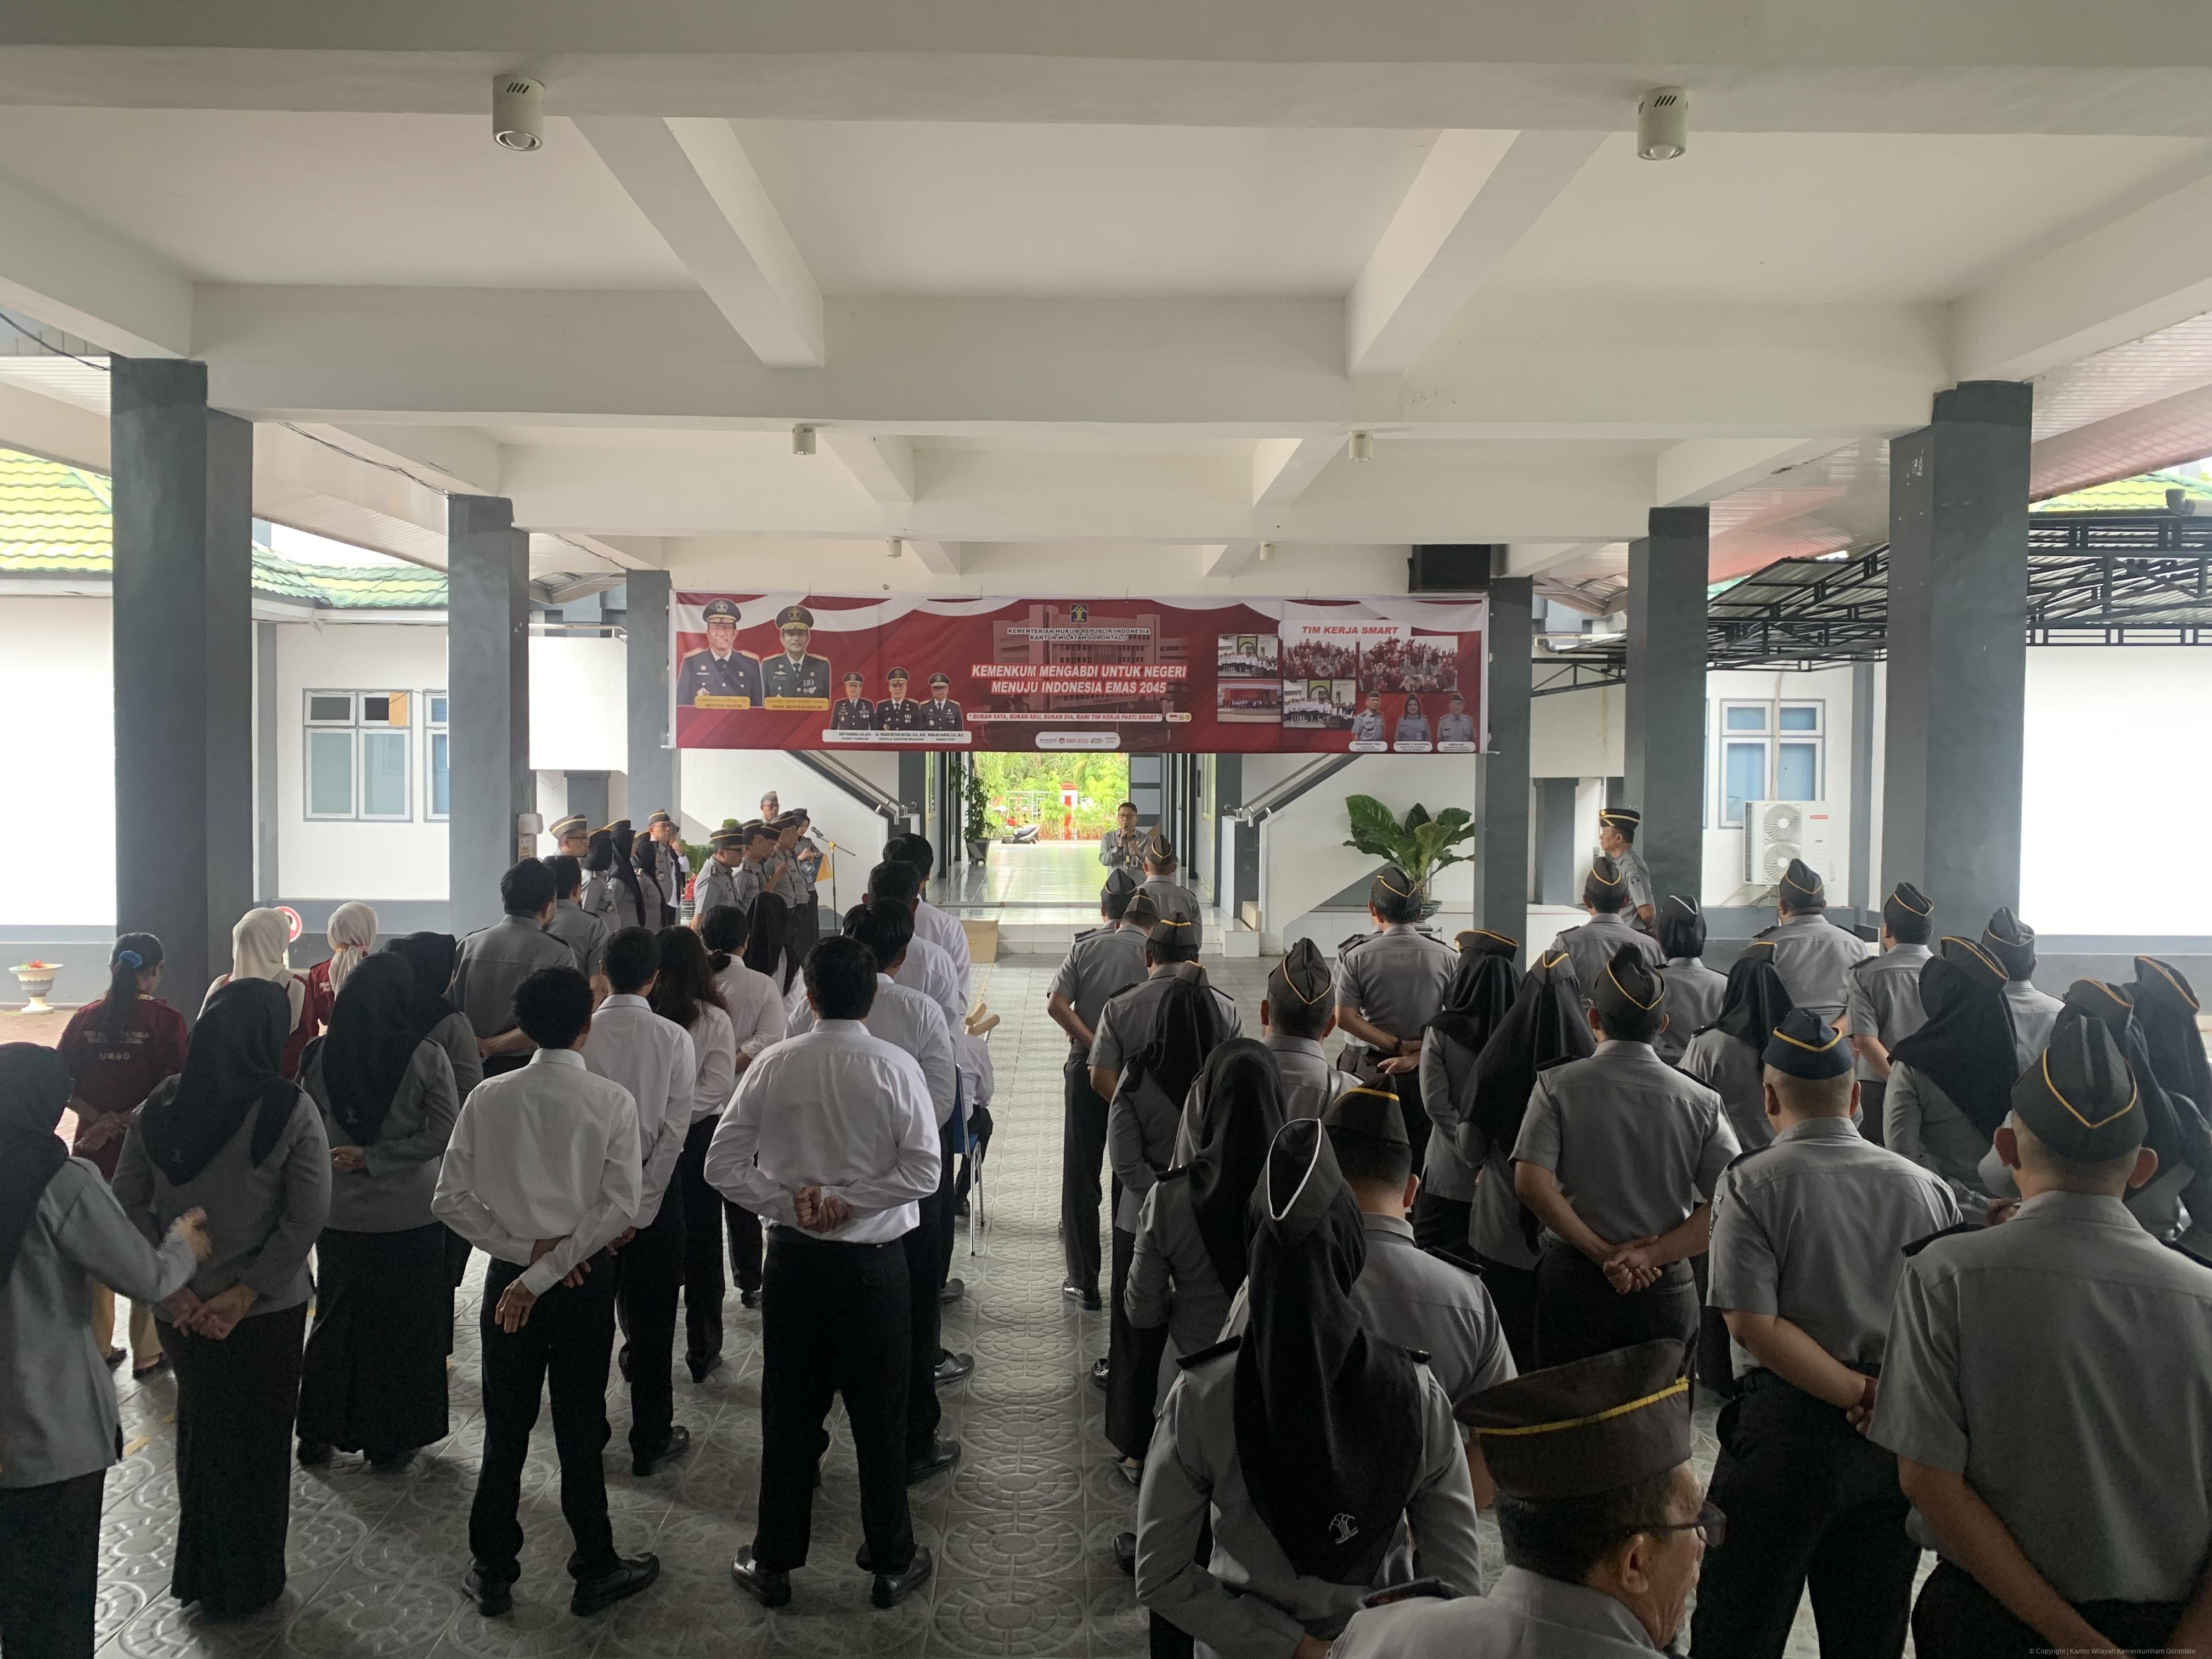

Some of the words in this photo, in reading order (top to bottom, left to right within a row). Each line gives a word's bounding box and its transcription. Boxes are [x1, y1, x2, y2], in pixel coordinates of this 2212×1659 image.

[972, 665, 1036, 677] KEMENKUM
[1039, 665, 1098, 677] MENGABDI
[1101, 665, 1142, 678] UNTUK
[1144, 665, 1187, 678] NEGERI
[992, 681, 1039, 693] MENUJU
[1042, 681, 1102, 693] INDONESIA
[1105, 682, 1137, 693] EMAS
[1139, 682, 1166, 693] 2045
